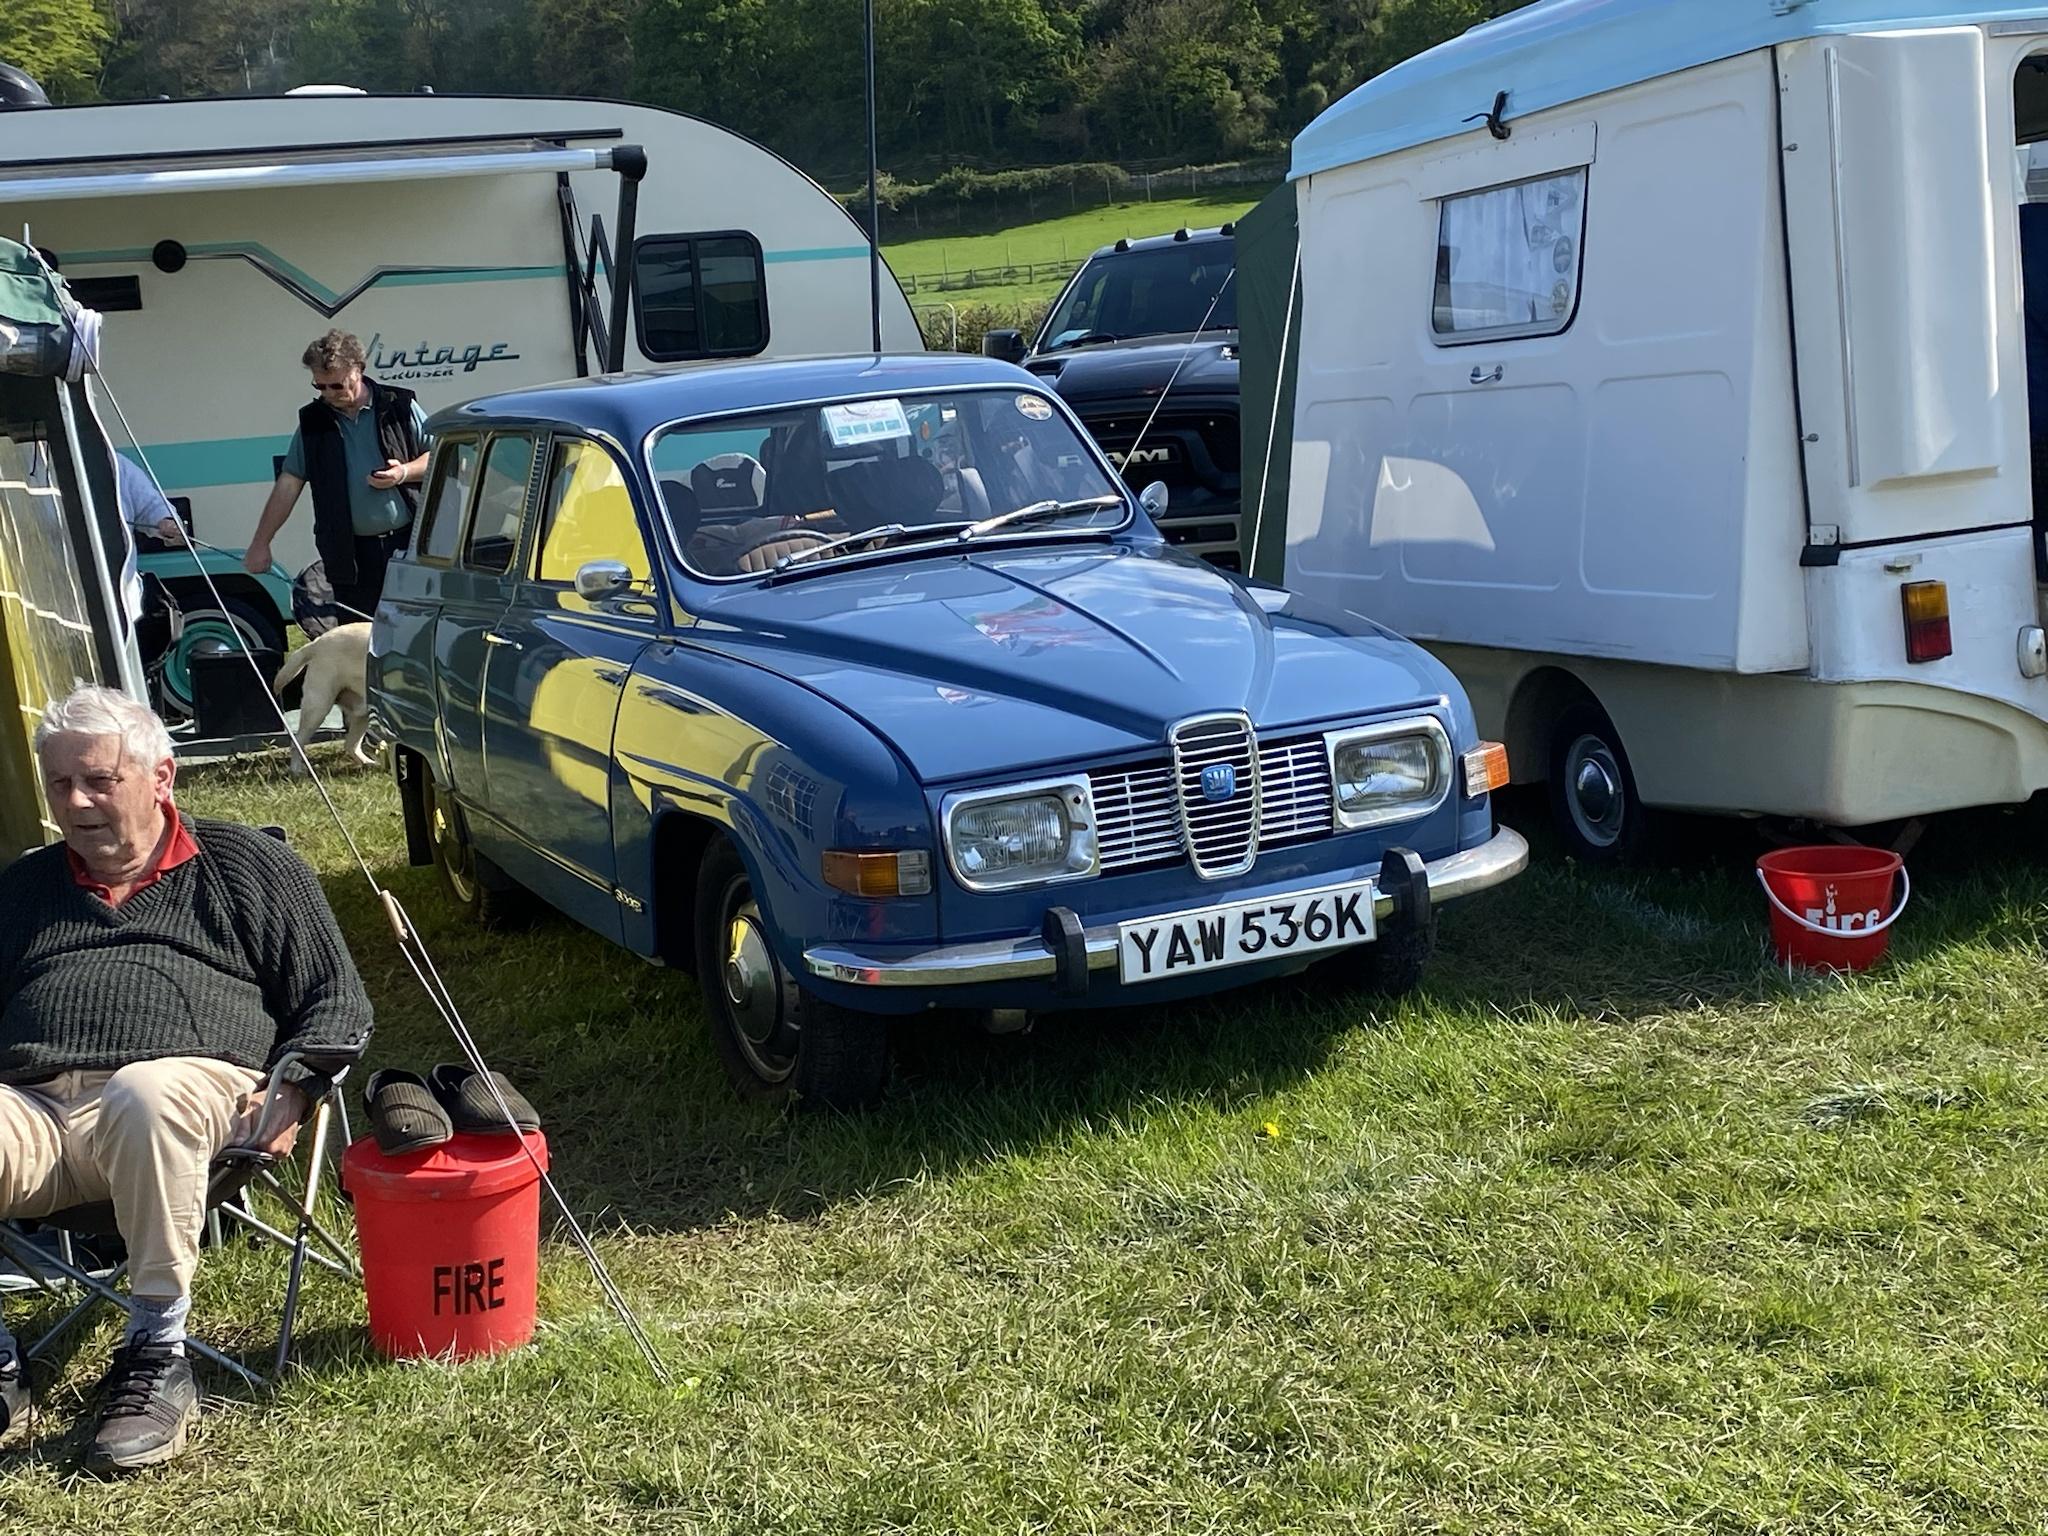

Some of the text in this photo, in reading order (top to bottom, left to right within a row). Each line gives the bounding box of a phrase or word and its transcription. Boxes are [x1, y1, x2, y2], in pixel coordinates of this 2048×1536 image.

[379, 367, 454, 381] CRUISER
[1129, 891, 1368, 974] YAW 536K
[433, 1257, 505, 1316] FIRE
